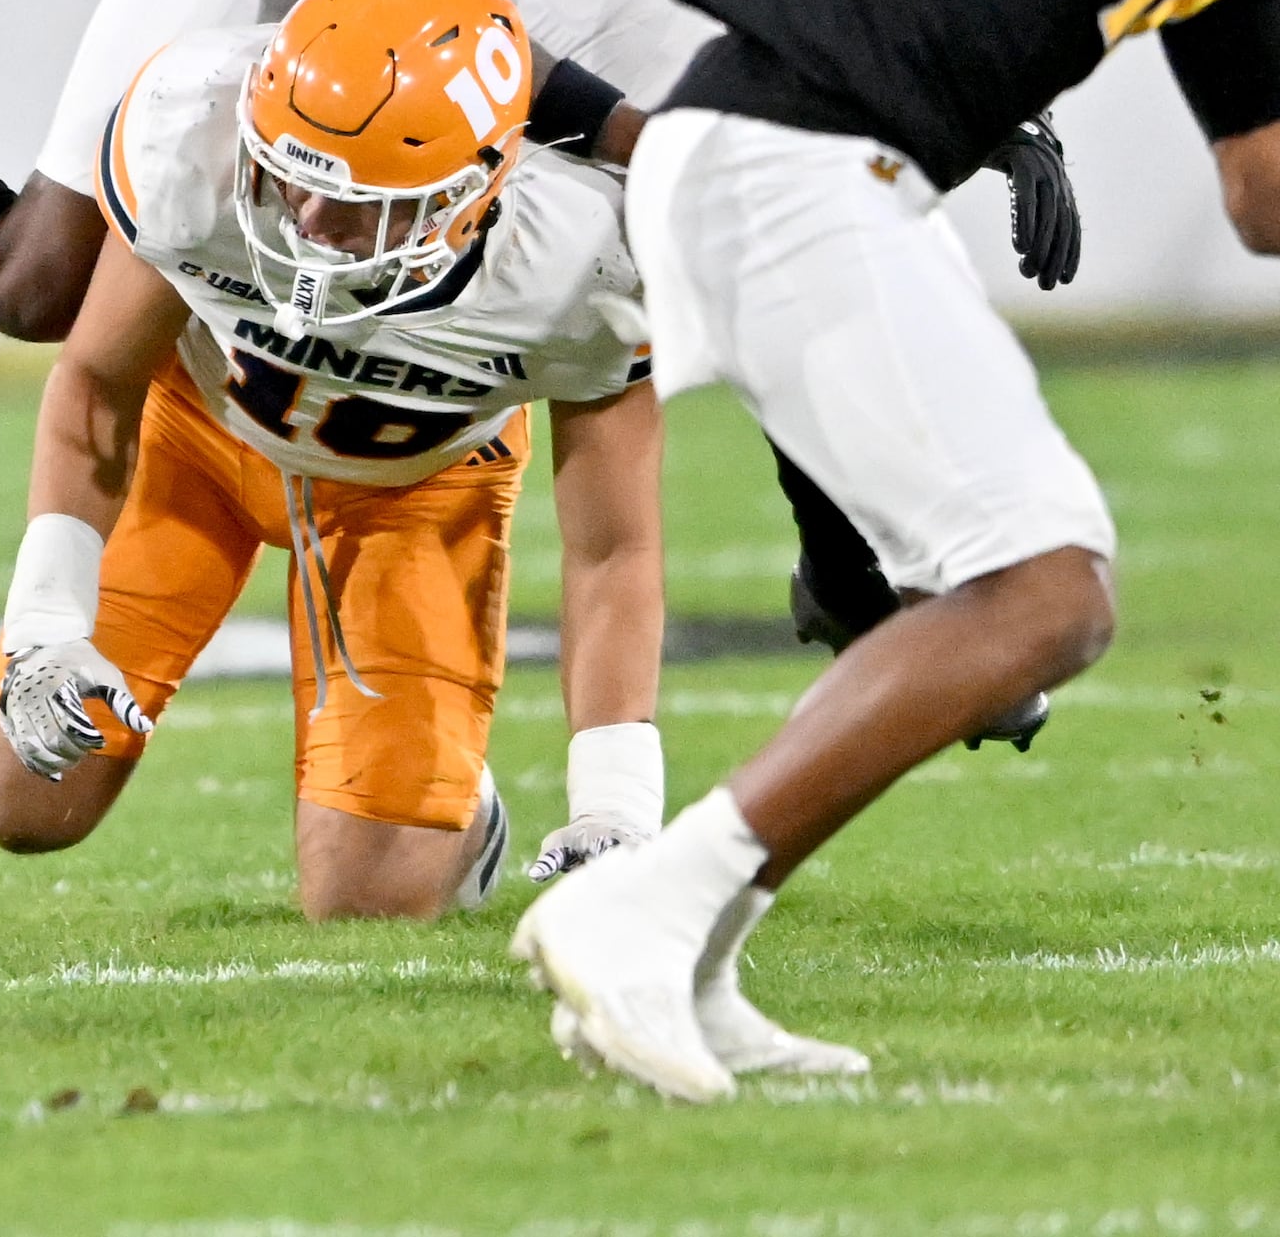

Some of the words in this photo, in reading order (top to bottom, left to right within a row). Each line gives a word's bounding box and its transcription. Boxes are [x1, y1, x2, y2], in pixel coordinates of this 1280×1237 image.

[443, 25, 523, 142] 10
[286, 143, 336, 173] UNITY
[234, 317, 496, 398] MINERS
